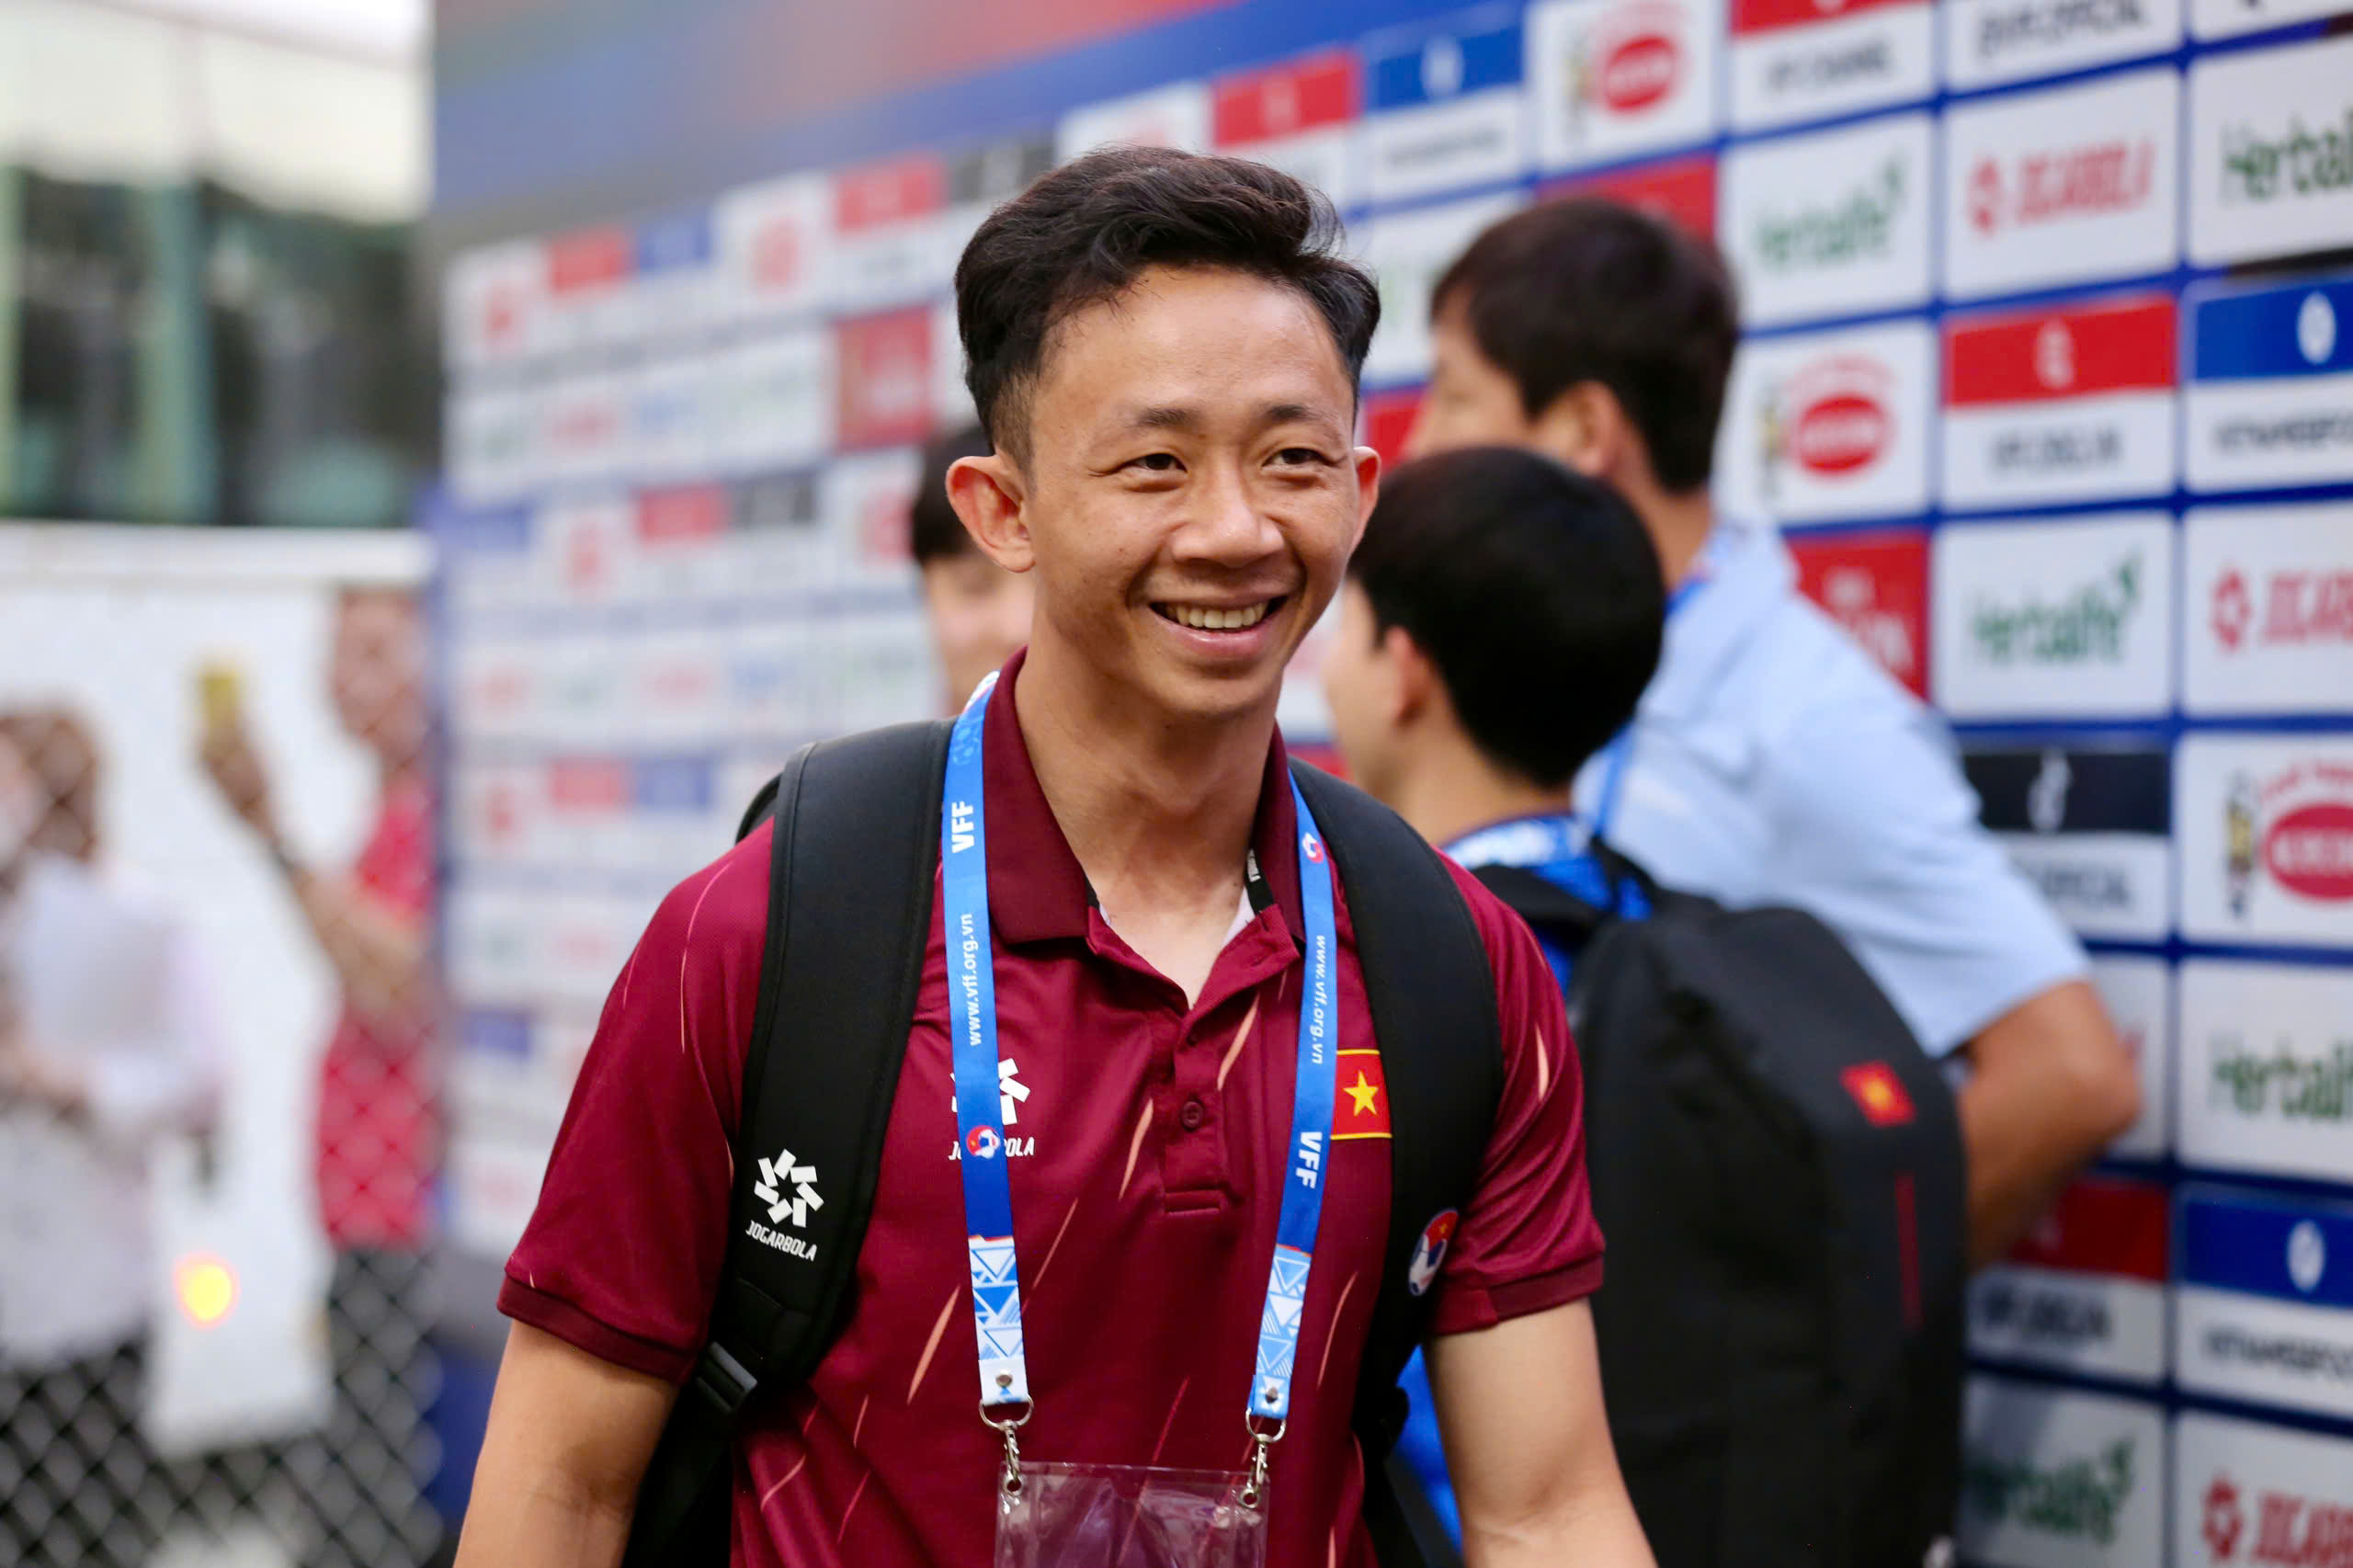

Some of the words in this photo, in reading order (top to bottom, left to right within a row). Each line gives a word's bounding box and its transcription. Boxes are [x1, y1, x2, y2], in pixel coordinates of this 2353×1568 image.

[950, 801, 975, 854] VFF
[961, 913, 983, 1047] www.vff.org.vn
[1310, 934, 1328, 1065] www.vff.org.vn
[1295, 1131, 1324, 1189] VFF
[745, 1219, 818, 1263] JOGARBOLA
